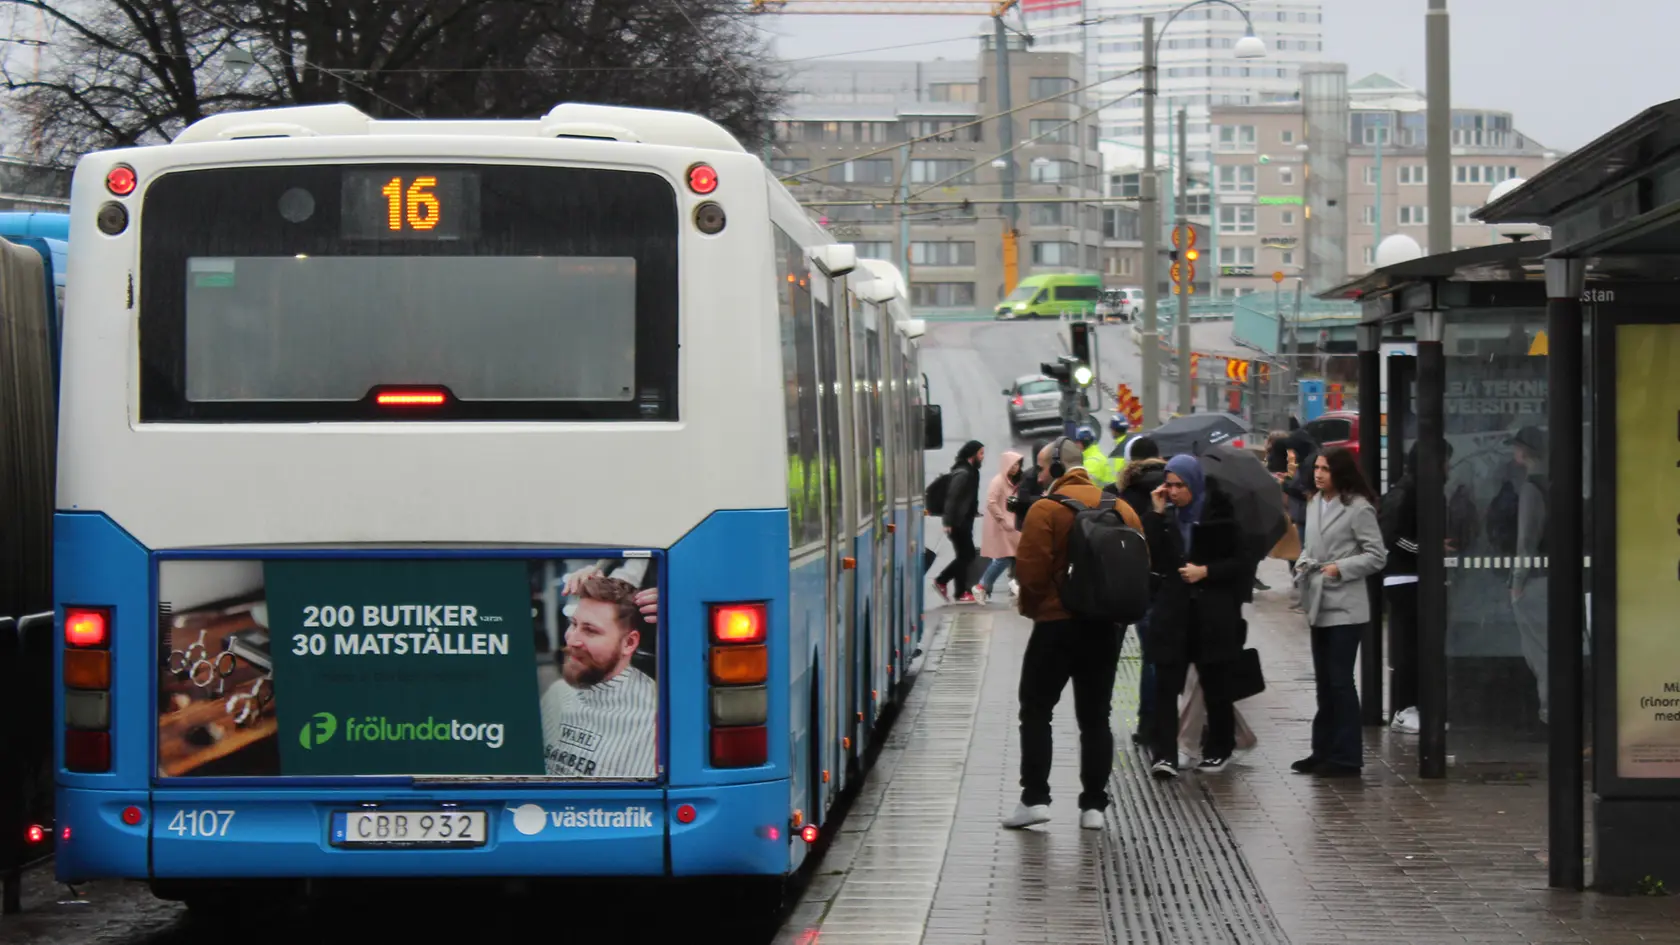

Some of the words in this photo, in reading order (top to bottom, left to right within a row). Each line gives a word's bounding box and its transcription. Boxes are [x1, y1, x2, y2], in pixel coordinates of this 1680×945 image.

[381, 175, 441, 231] 16
[1579, 288, 1615, 302] stan
[303, 605, 355, 627] 200
[363, 605, 478, 627] BUTIKER
[292, 633, 327, 656] 30
[334, 627, 509, 656] MATSTÄLLEN
[346, 716, 505, 749] frölundatorg
[561, 726, 595, 747] WAHL
[167, 809, 236, 837] 4107
[357, 815, 409, 838] CBB
[419, 815, 472, 838] 932
[552, 807, 653, 828] västtrafik
